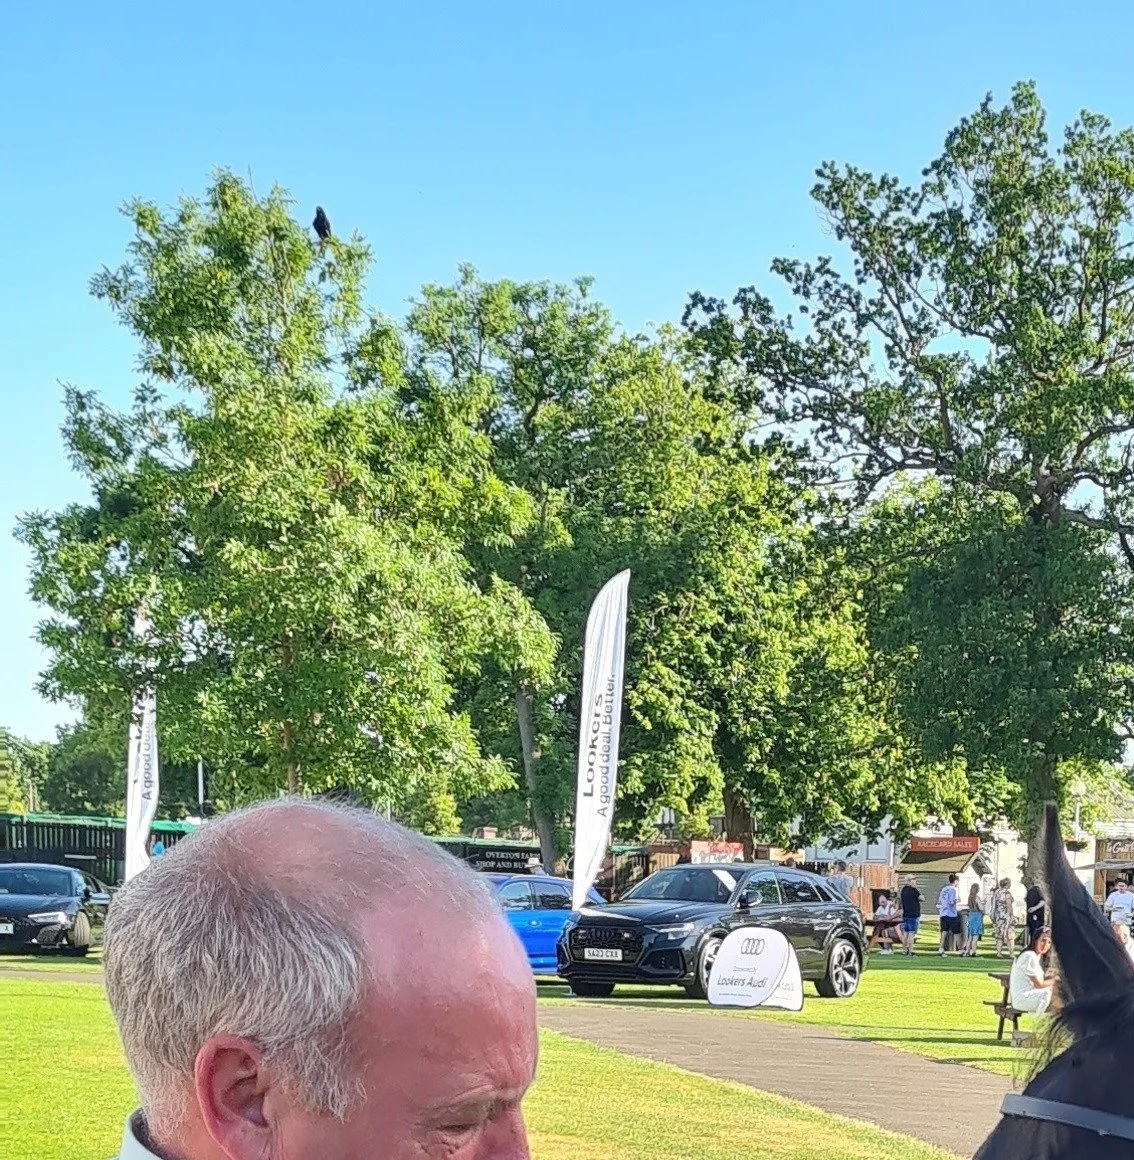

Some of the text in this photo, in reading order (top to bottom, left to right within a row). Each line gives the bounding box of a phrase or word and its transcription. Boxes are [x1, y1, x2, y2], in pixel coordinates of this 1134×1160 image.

[583, 692, 603, 797] Lookers
[142, 753, 154, 789] good
[598, 765, 611, 803] good
[141, 791, 152, 801] A
[597, 806, 607, 817] A
[485, 851, 520, 859] OVERTON
[716, 974, 746, 987] Lookers
[746, 976, 769, 988] Audi
